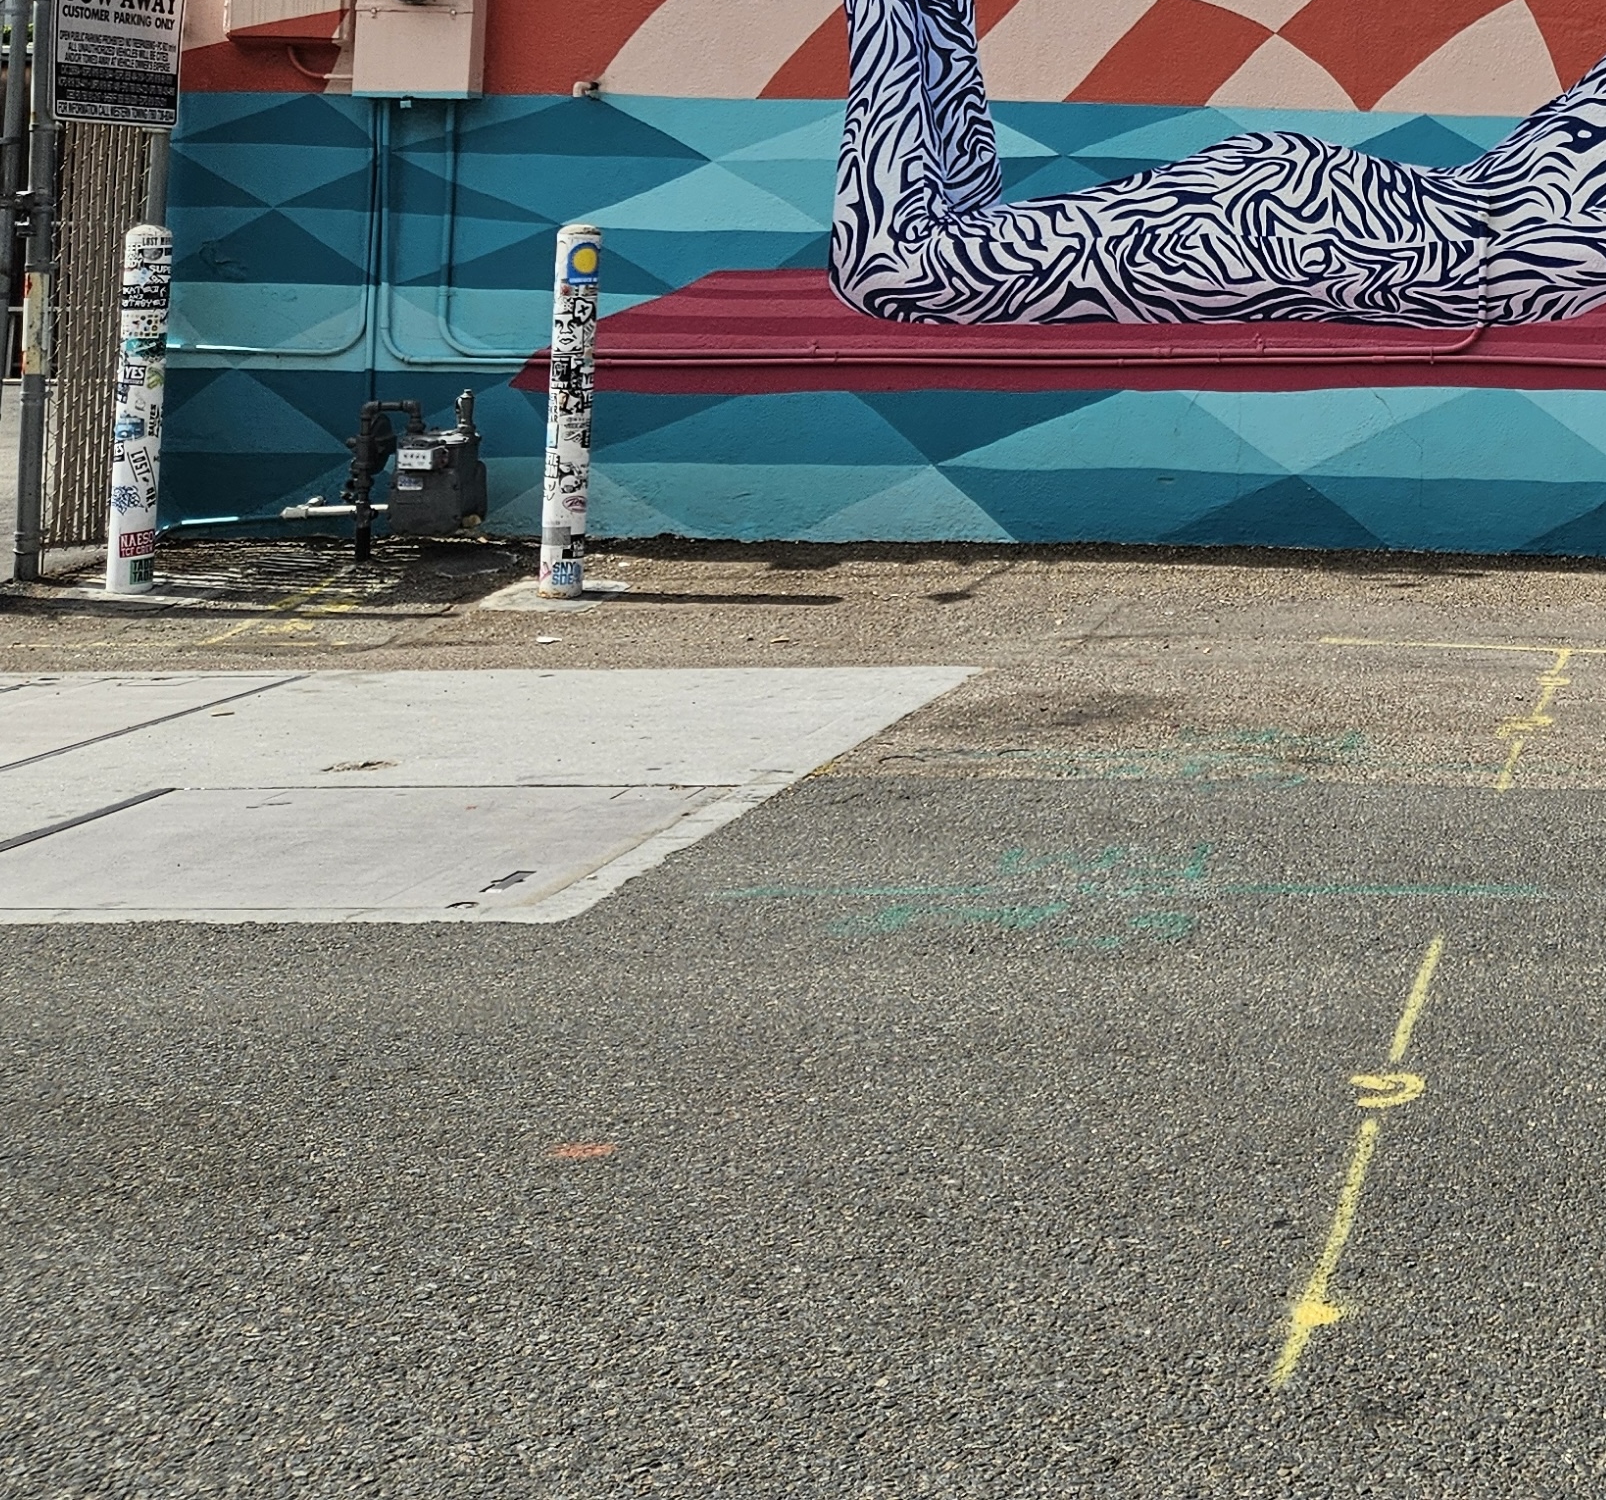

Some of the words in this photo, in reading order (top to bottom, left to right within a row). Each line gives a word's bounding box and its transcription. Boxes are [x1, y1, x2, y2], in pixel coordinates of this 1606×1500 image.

[62, 5, 110, 23] CUSTOMER
[113, 11, 151, 28] PARKING
[154, 17, 175, 30] ONLY
[125, 366, 145, 379] YES
[131, 450, 151, 476] LOST
